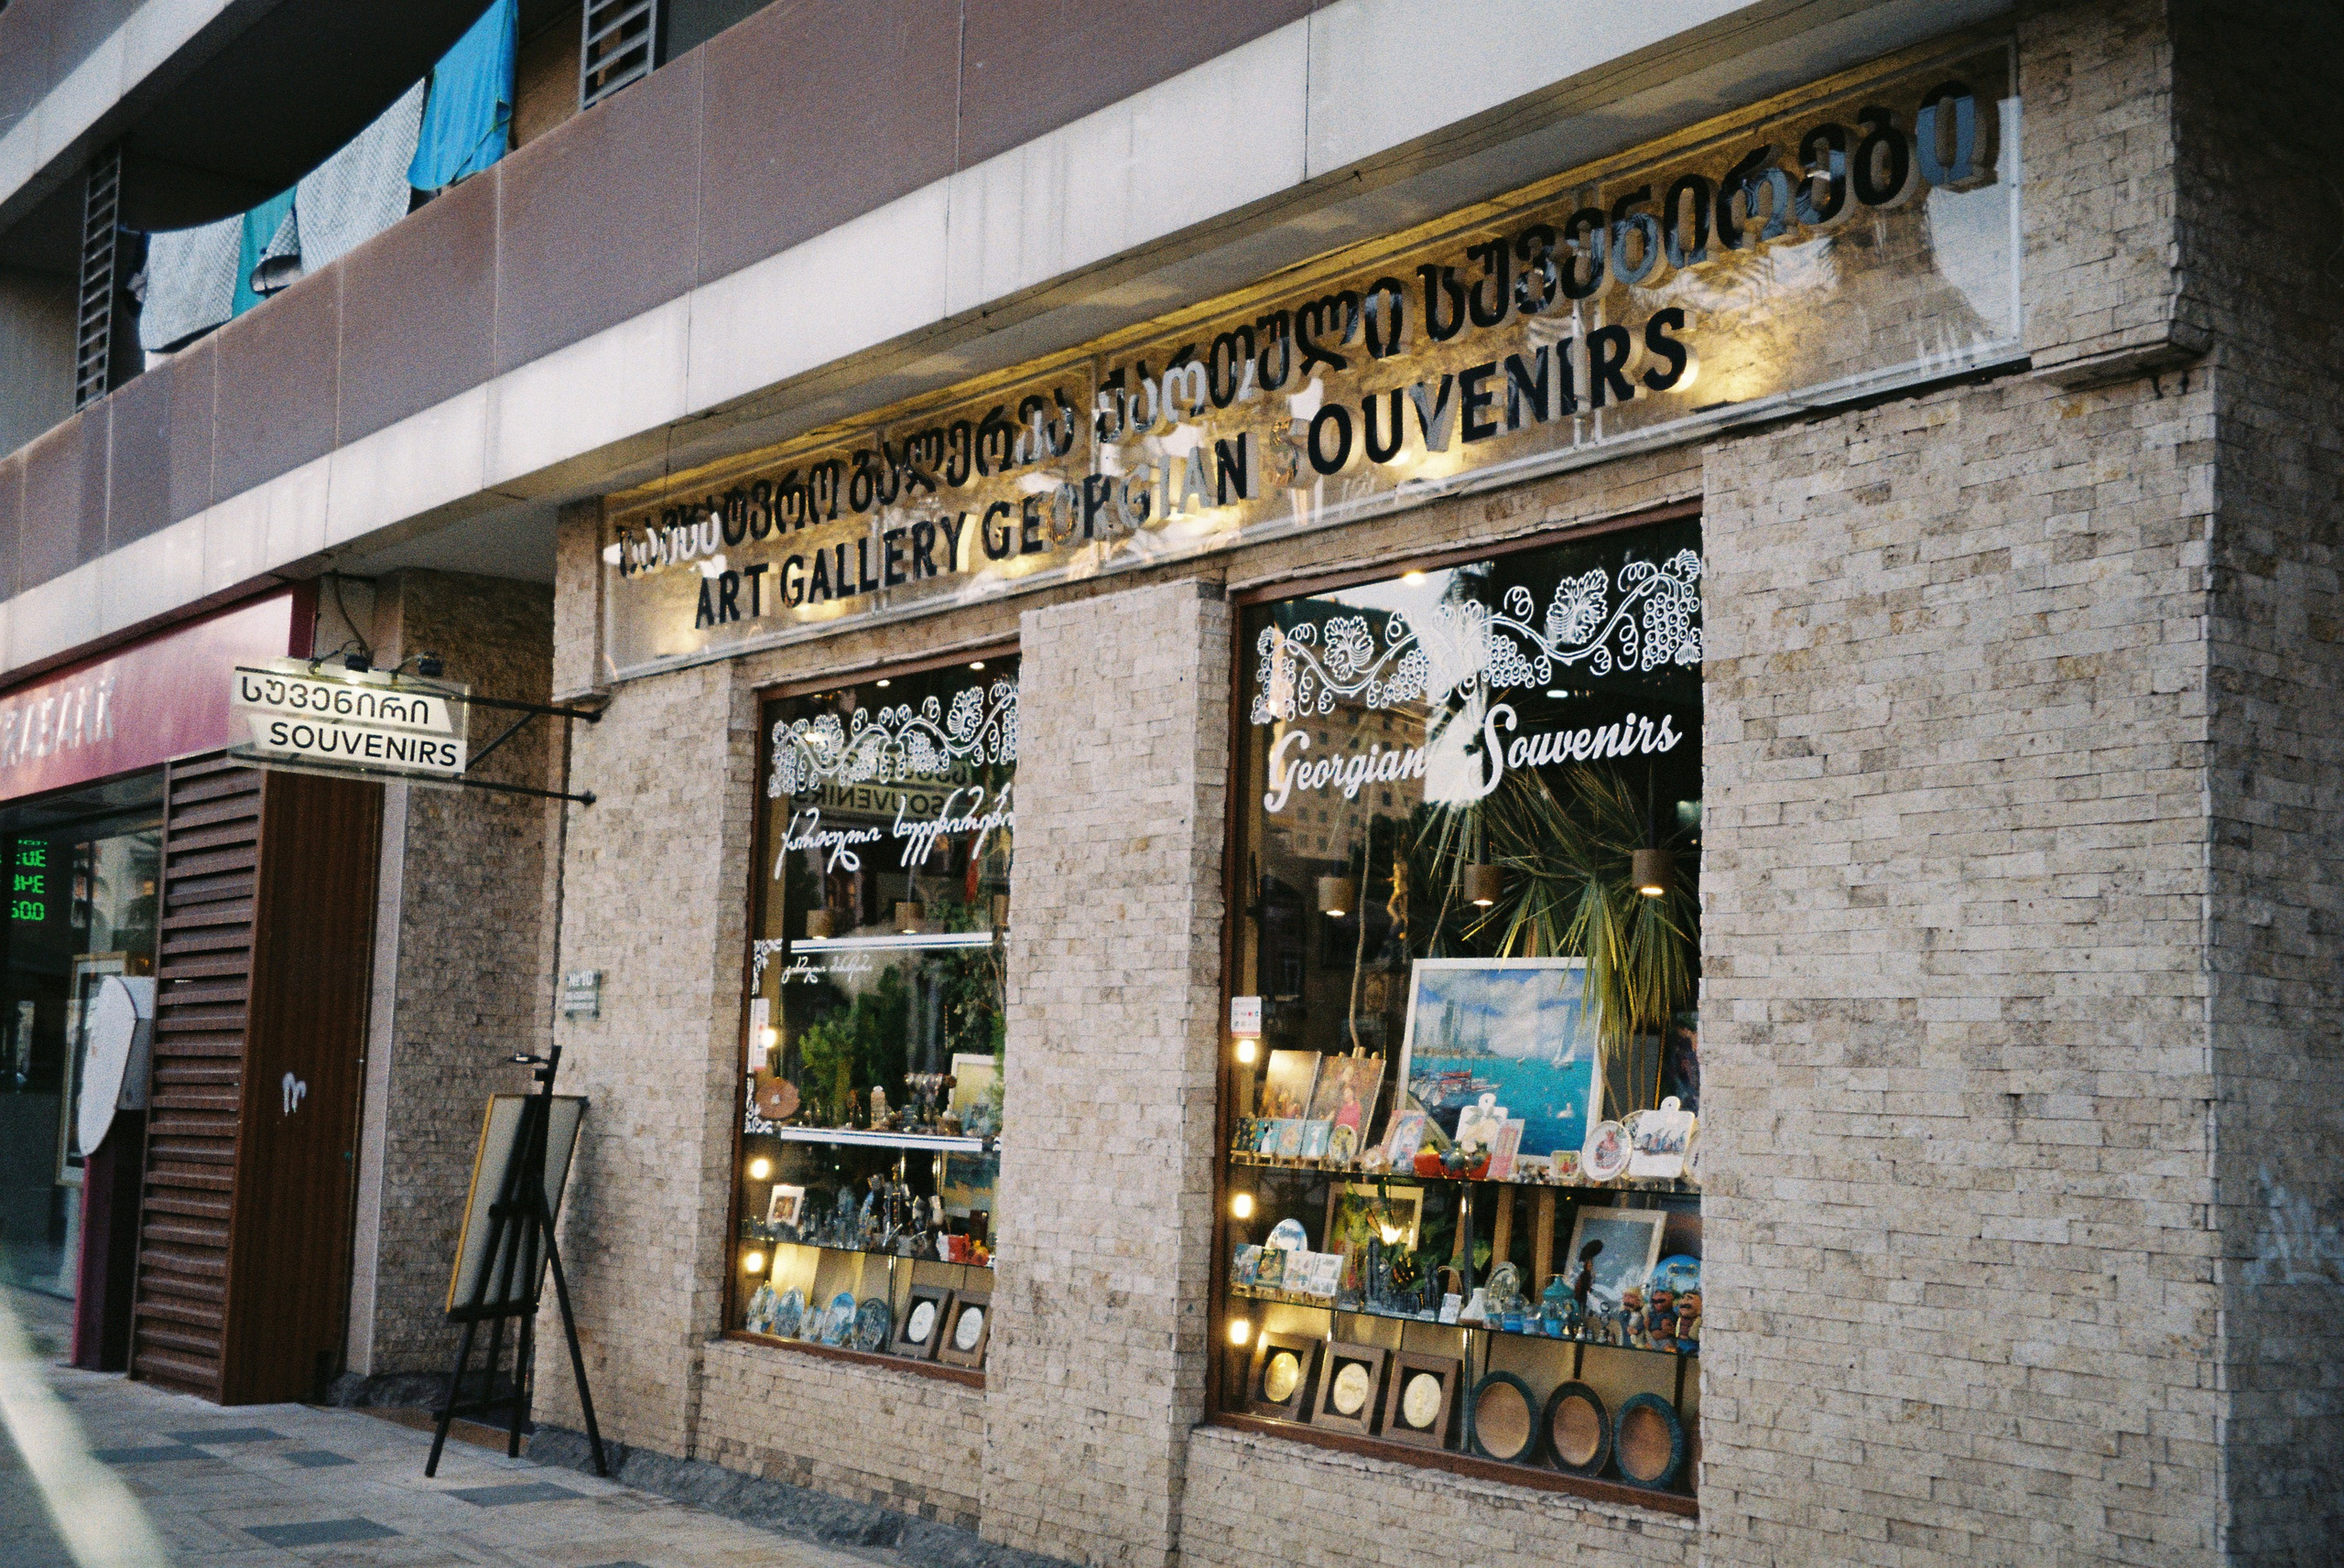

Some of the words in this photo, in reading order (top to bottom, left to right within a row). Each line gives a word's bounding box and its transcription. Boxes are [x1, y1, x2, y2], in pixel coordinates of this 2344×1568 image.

[850, 387, 1075, 512] გალერეა
[1096, 276, 1404, 444] ქართული
[1416, 81, 1979, 343] სუვენირები
[695, 563, 770, 630] ART
[780, 511, 967, 609] GALLERY
[982, 431, 1248, 560] GEORGIAN
[241, 675, 430, 725] სუვენირი
[269, 720, 457, 767] SOUVENIRS
[1264, 730, 1428, 813] Georgian
[1467, 703, 1683, 798] Souvenirs
